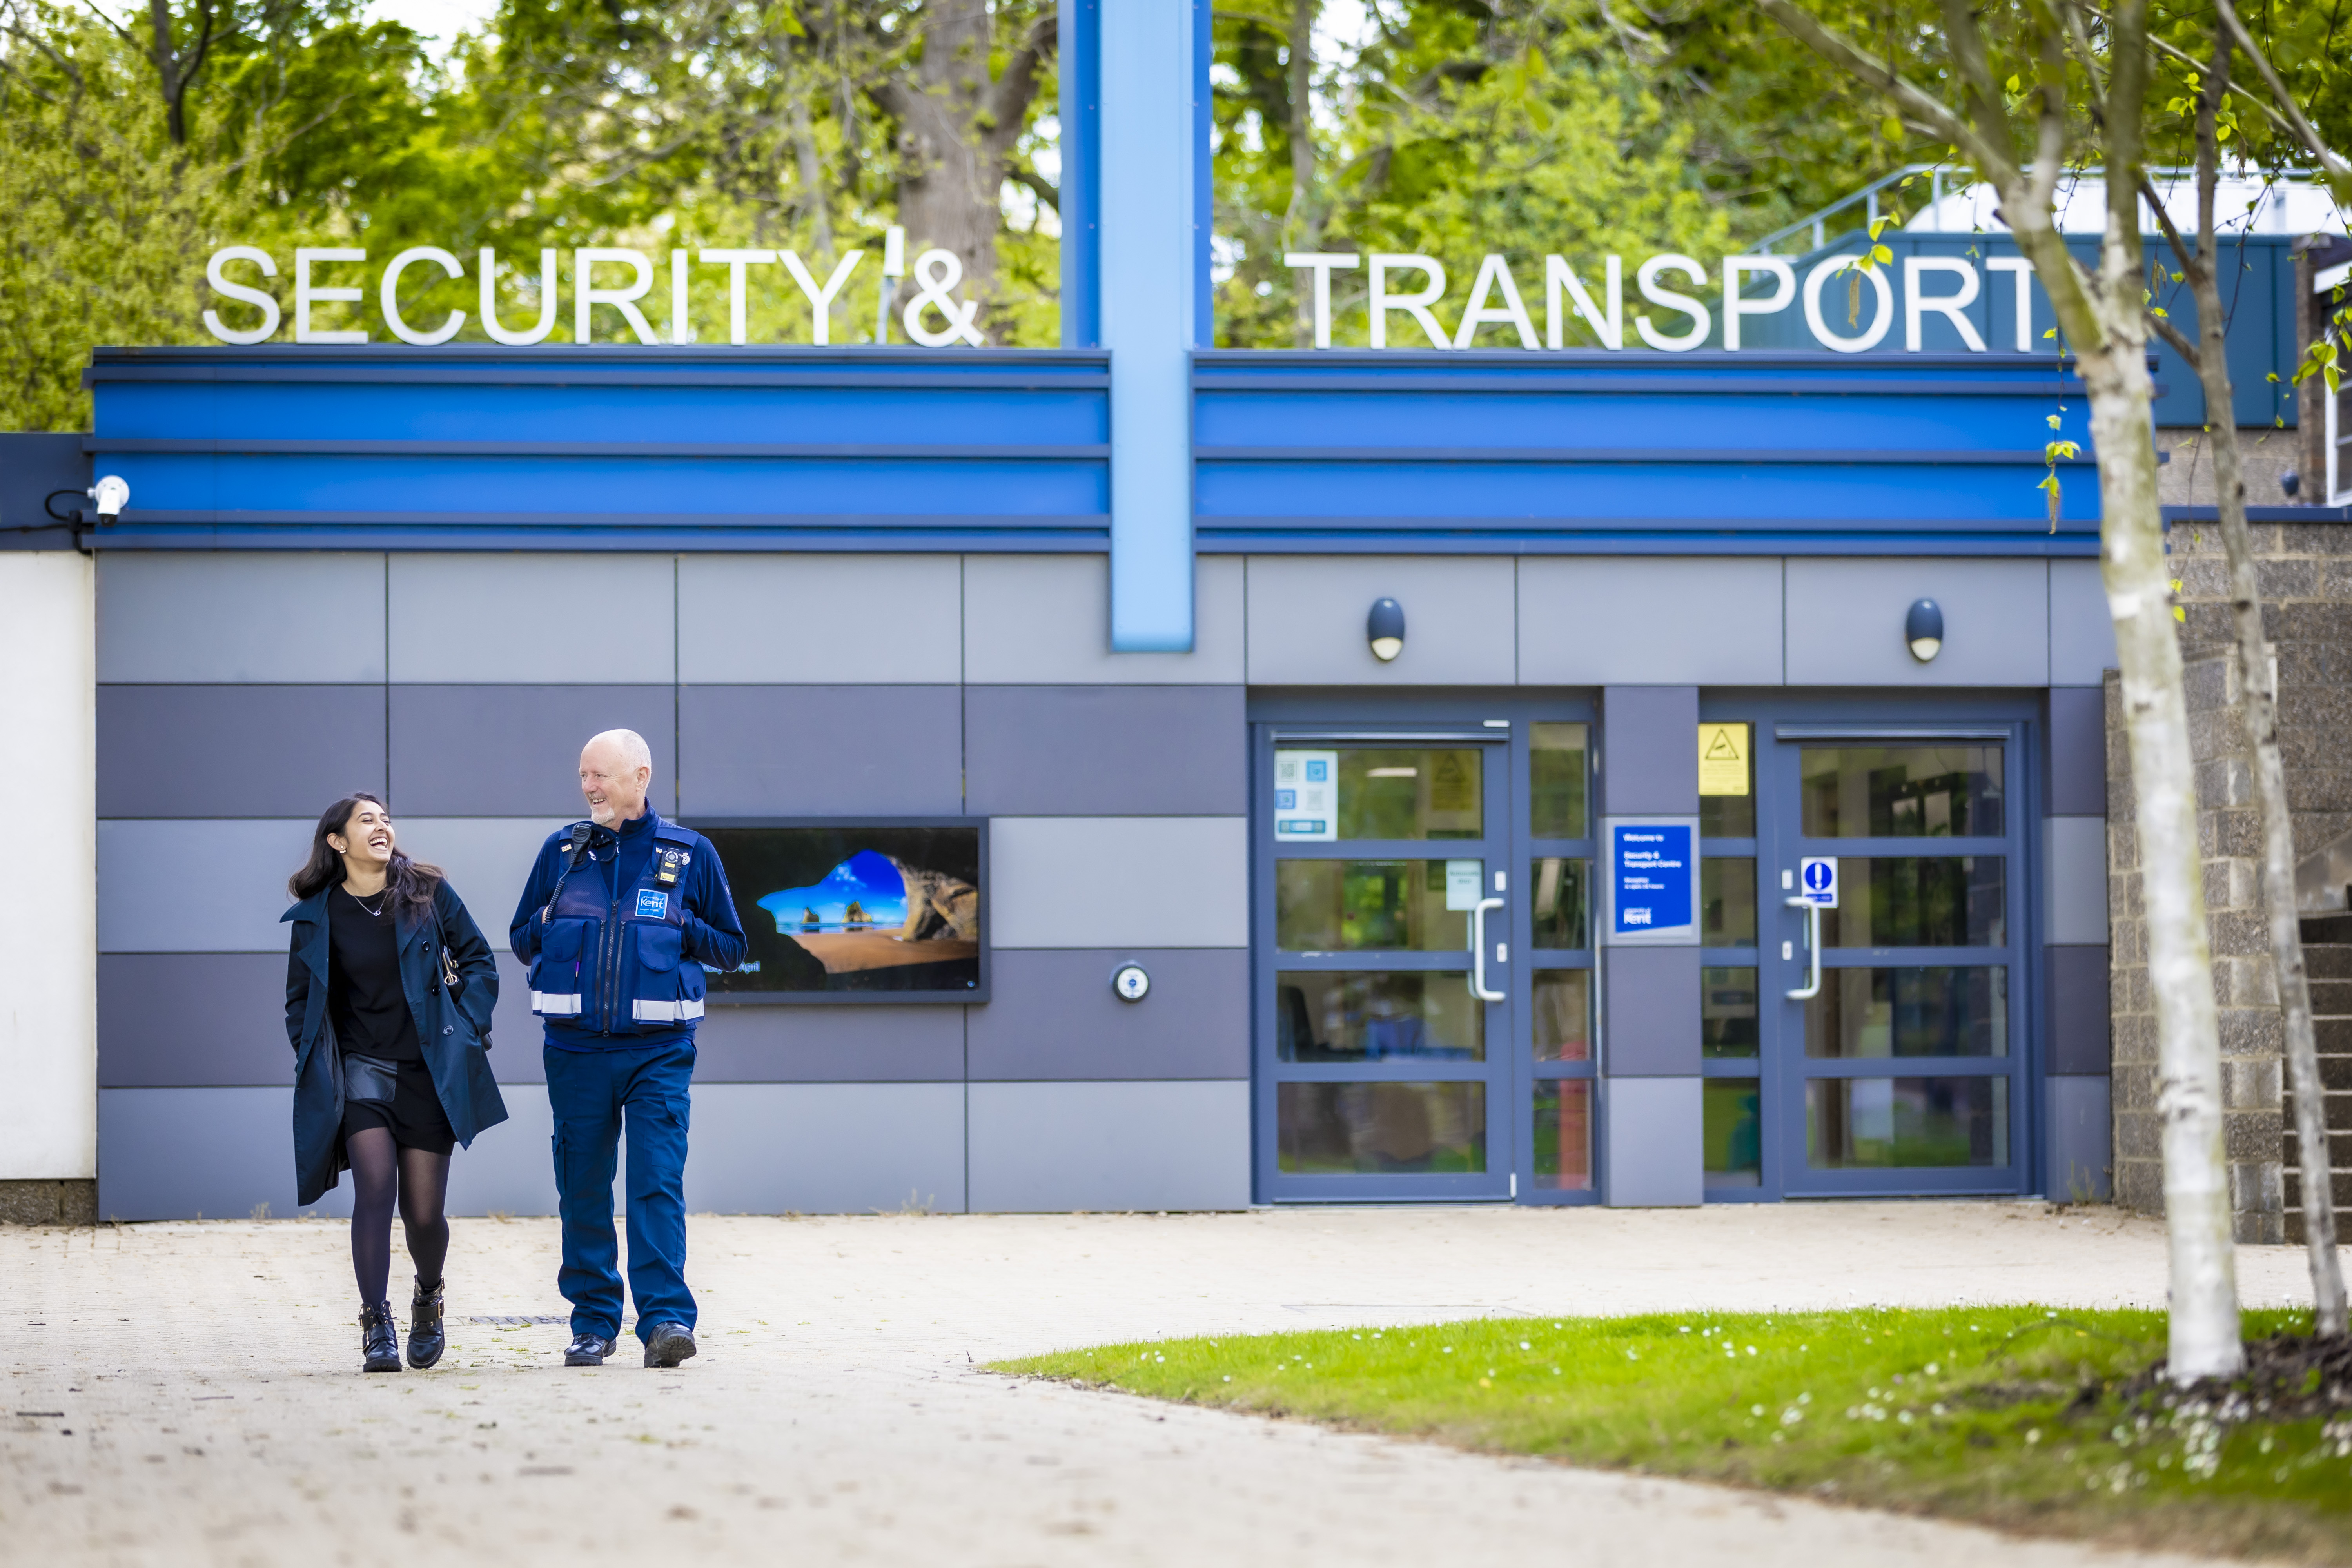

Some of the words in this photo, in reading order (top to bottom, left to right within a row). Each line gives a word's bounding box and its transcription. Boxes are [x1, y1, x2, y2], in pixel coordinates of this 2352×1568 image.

[203, 246, 865, 346] SECURITY
[902, 248, 985, 348] &
[1284, 252, 2036, 353] TRANSPORT
[1623, 833, 1655, 842] Welcome
[1624, 851, 1652, 860] Security
[1653, 851, 1660, 859] &
[1624, 859, 1657, 869] Transport
[1657, 859, 1682, 868] Centre
[640, 898, 663, 908] Kent
[1624, 913, 1651, 924] Kent
[738, 961, 760, 974] April
